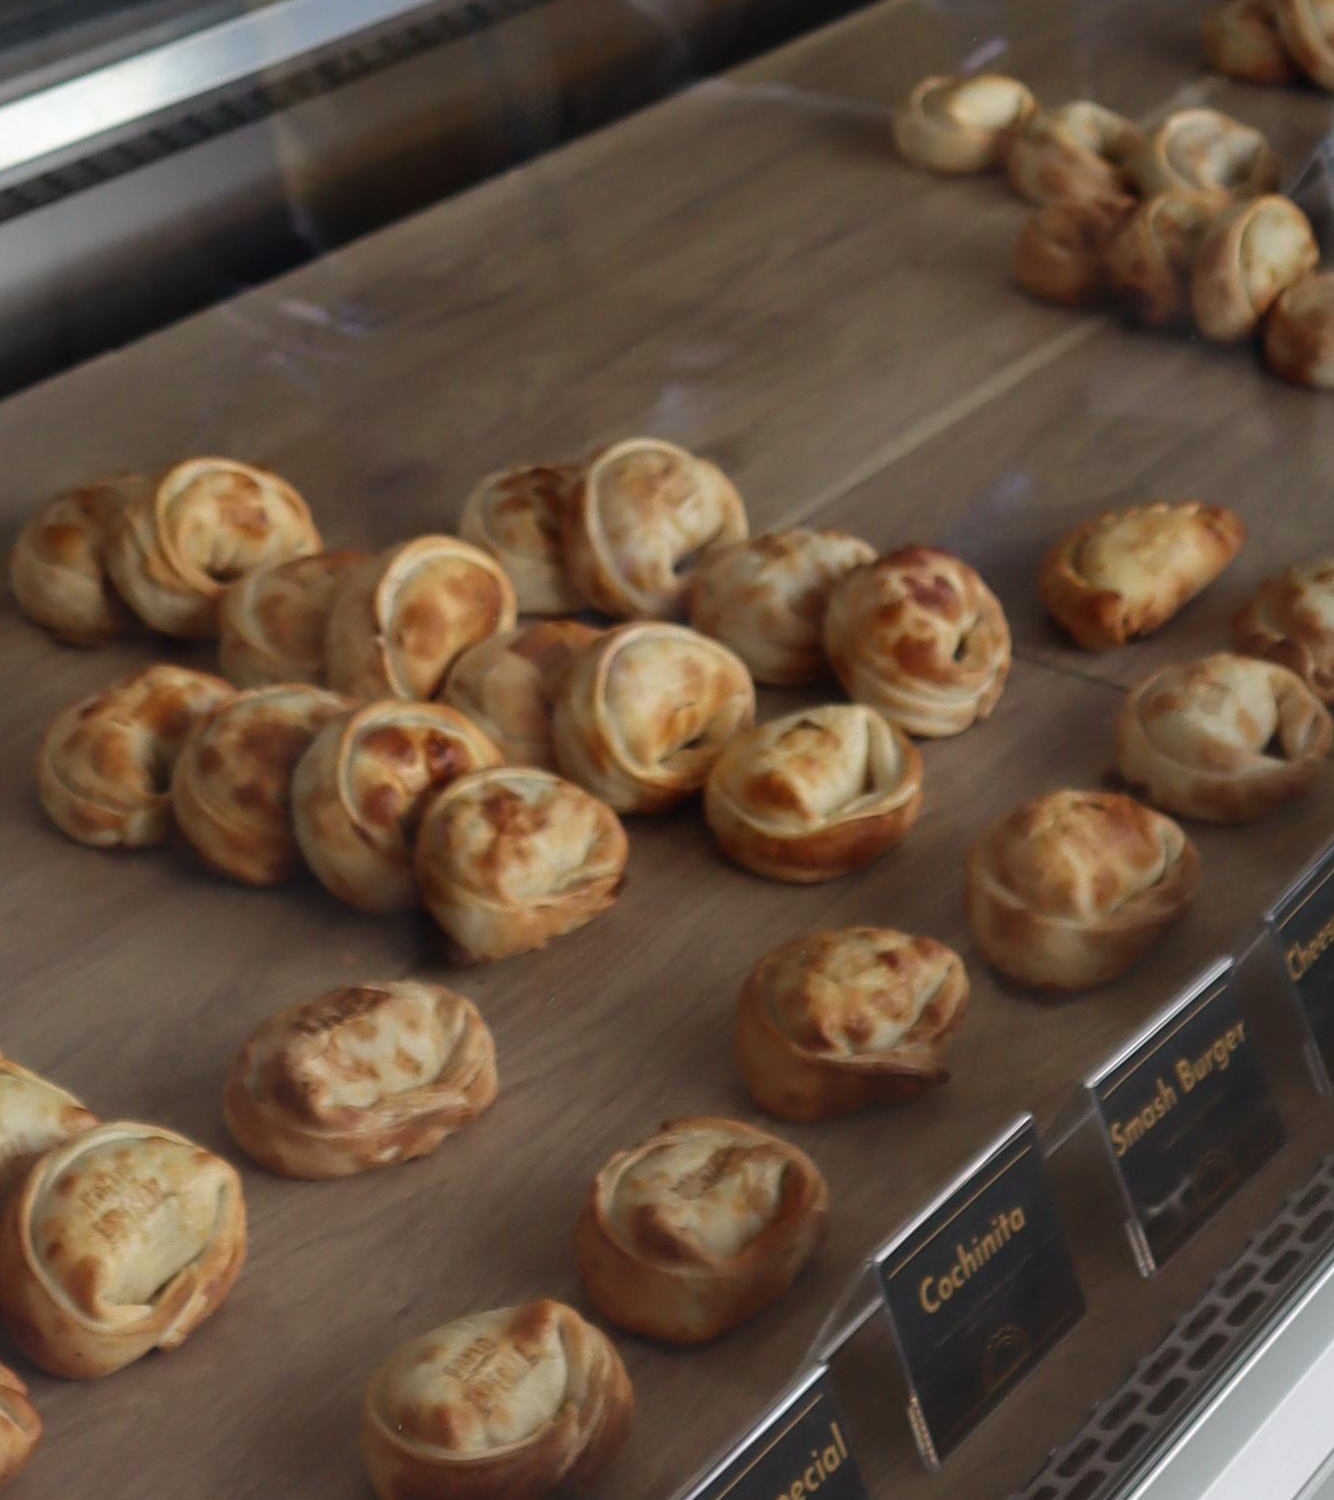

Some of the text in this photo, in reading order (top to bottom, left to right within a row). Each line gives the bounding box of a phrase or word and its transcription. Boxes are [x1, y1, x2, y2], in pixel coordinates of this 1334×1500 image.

[1110, 1019, 1248, 1159] Smash Burger
[918, 1205, 1026, 1315] Cochinita
